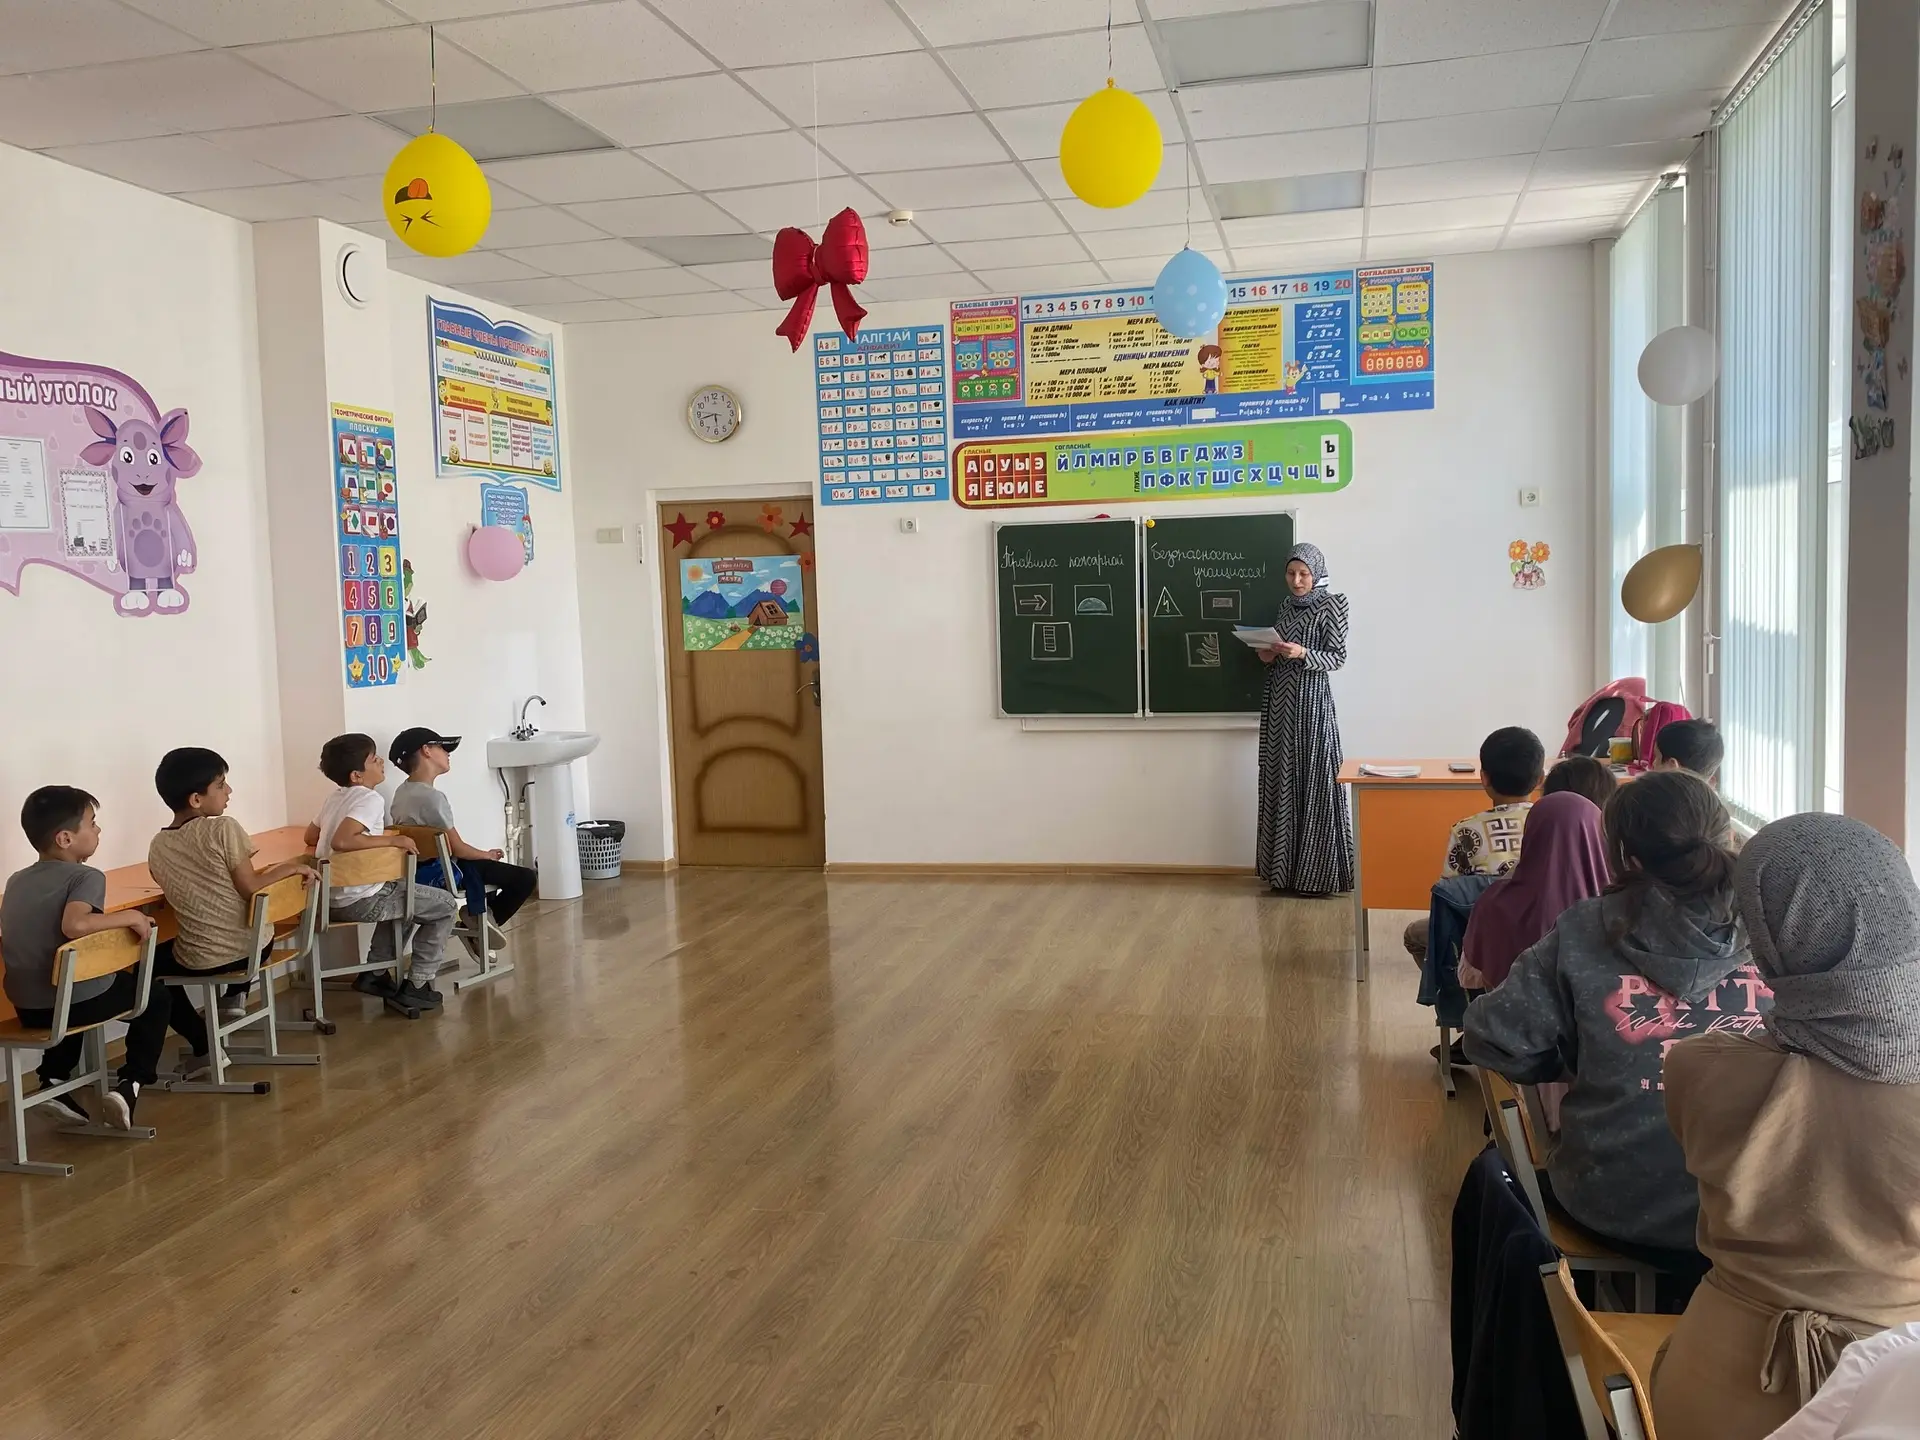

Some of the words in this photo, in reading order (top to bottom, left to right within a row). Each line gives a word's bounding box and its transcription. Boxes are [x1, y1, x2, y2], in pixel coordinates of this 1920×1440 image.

[1024, 305, 1030, 314] 1
[1035, 304, 1042, 313] 2
[1047, 303, 1054, 312] 3
[1058, 302, 1065, 311] 4
[1071, 301, 1077, 311] 5
[1082, 301, 1089, 310] 6
[1094, 300, 1101, 309] 7
[1106, 299, 1112, 308] 8
[1117, 297, 1124, 307] 9
[1129, 296, 1144, 306] 10
[1230, 287, 1246, 297] 15
[1251, 286, 1267, 296] 16
[1271, 284, 1287, 294] 17
[1292, 283, 1308, 293] 18
[1314, 281, 1330, 291] 19
[1335, 279, 1351, 290] 20
[1033, 325, 1049, 333] МЕРА
[1050, 324, 1073, 332] ДЛИНЫ
[436, 318, 472, 338] ГЛАВНЫЕ
[472, 329, 498, 346] ЧЛЕНЫ
[498, 336, 548, 359] ПРЕДЛОЖЕНИЯ
[857, 343, 900, 351] АЛФАВИТ
[1113, 351, 1147, 361] ЕДИНИЦЫ
[1148, 349, 1189, 359] ИЗМЕРЕНИЯ
[1059, 368, 1076, 376] МЕРА
[1077, 366, 1107, 375] ПЛОЩАДИ
[41, 382, 117, 411] УГОЛОК
[711, 392, 718, 400] 12
[1164, 398, 1180, 407] КАК
[1181, 397, 1206, 406] НАЙТИ?
[697, 402, 704, 410] 10
[726, 400, 732, 408] 2
[335, 408, 374, 421] ГЕОМЕТРИЧЕСКИЕ
[729, 409, 734, 417] 3
[349, 422, 379, 434] ПЛОСКИЕ
[348, 551, 355, 571] 1
[366, 552, 374, 573] 2
[384, 554, 392, 574] 3
[348, 588, 357, 608] 4
[368, 587, 376, 607] 5
[386, 587, 394, 606] 6
[351, 622, 359, 642] 7
[388, 621, 395, 641] 9
[367, 653, 388, 684] 10
